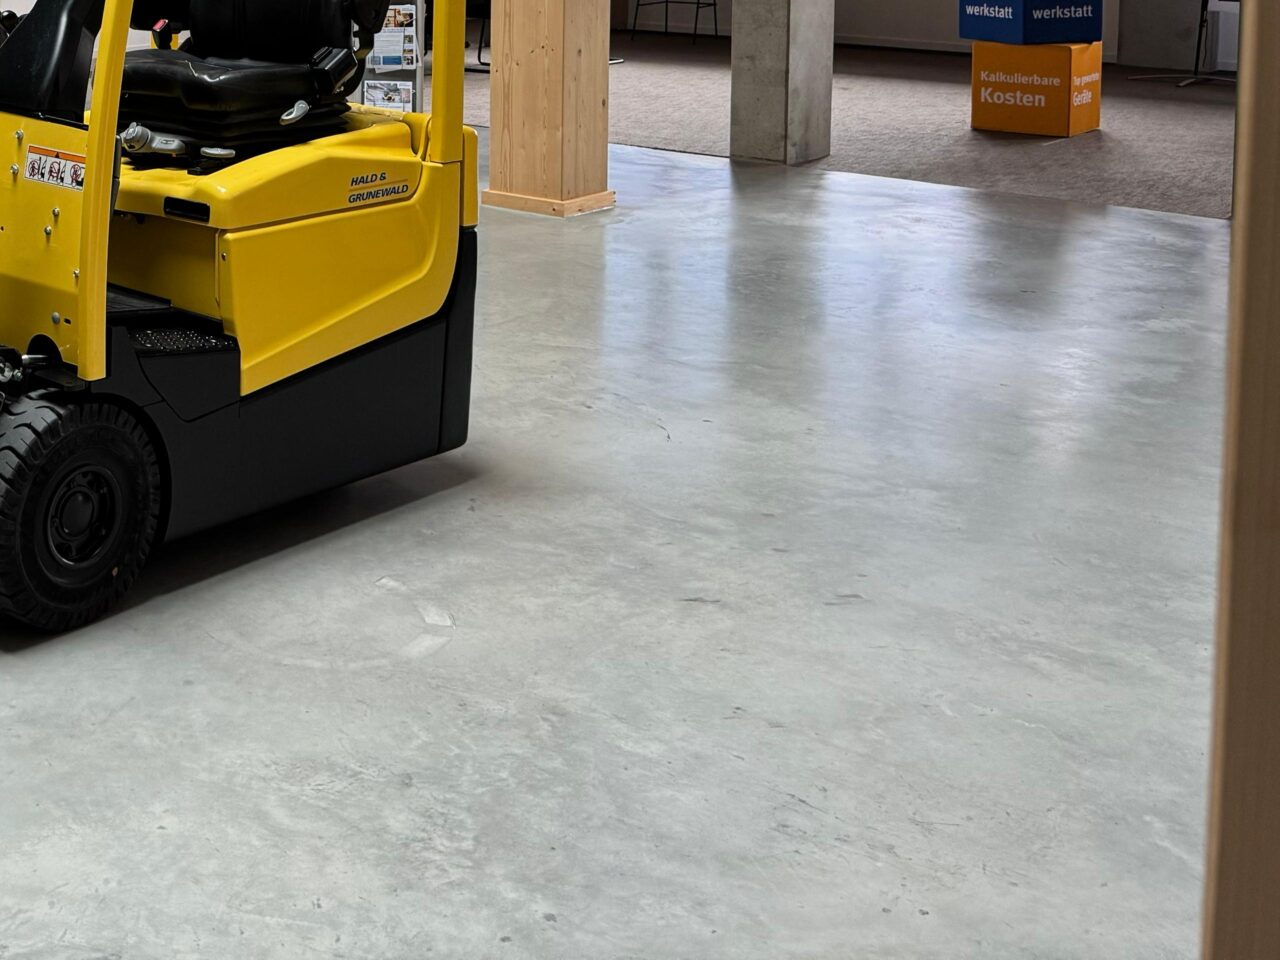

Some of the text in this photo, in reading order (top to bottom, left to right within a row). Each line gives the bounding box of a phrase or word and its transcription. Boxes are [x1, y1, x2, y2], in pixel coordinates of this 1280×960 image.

[965, 3, 1013, 19] werkstatt
[1032, 5, 1093, 19] werkstatt
[980, 71, 1060, 86] Kalkulierbare
[980, 87, 1046, 107] Kosten
[351, 172, 387, 186] HALD &
[348, 184, 408, 203] GRUNEWALD
